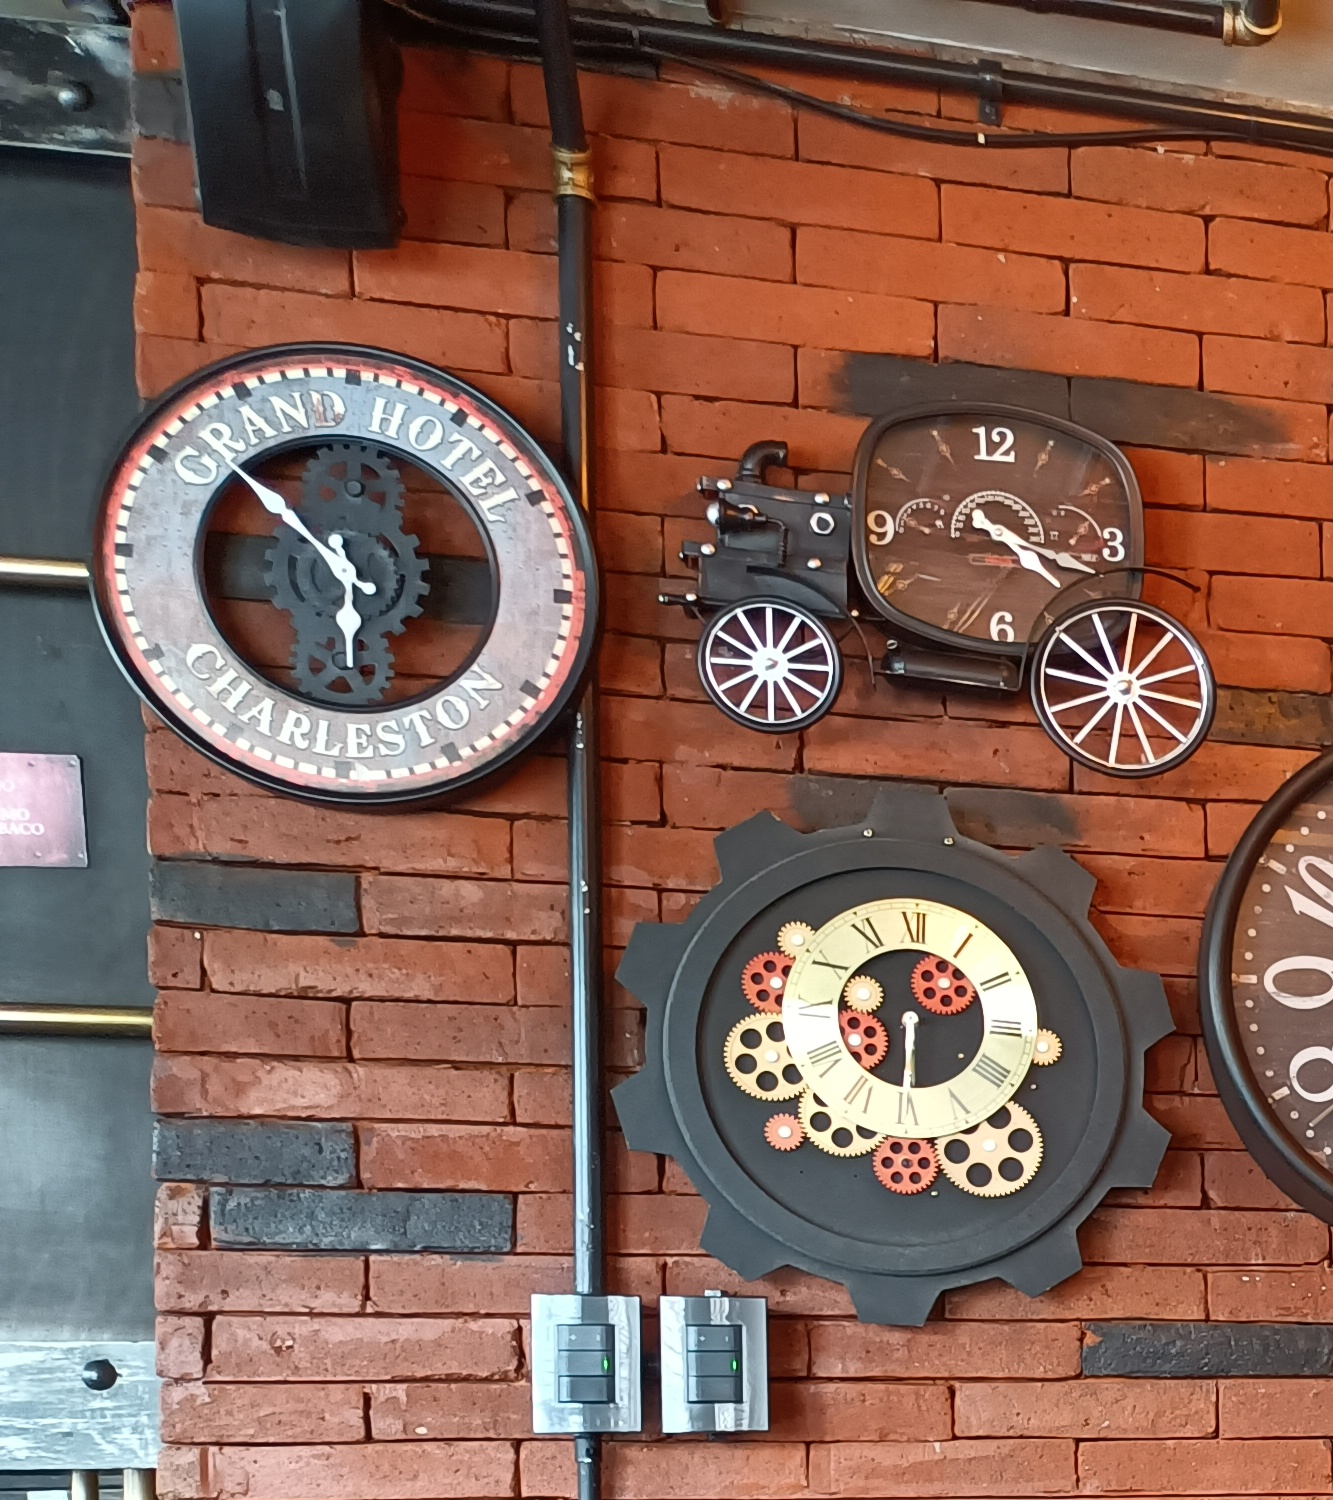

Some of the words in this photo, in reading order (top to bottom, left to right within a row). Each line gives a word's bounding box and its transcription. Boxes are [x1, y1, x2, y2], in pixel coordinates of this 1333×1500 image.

[173, 390, 344, 487] GRAND
[370, 395, 523, 525] HOTEL
[972, 426, 1015, 462] 12
[867, 510, 895, 545] 9
[1102, 528, 1125, 562] 3
[989, 611, 1015, 642] 6
[185, 641, 503, 759] CHARLESTON
[851, 917, 885, 954] XI
[900, 911, 927, 944] XII
[953, 933, 973, 958] I
[812, 950, 851, 979] X
[980, 971, 1012, 992] II
[798, 994, 833, 1018] IX
[989, 1019, 1022, 1037] III
[807, 1040, 842, 1078] VIII
[972, 1053, 1011, 1088] IIII
[843, 1075, 874, 1114] VII
[897, 1091, 918, 1126] VI
[948, 1086, 971, 1121] V
